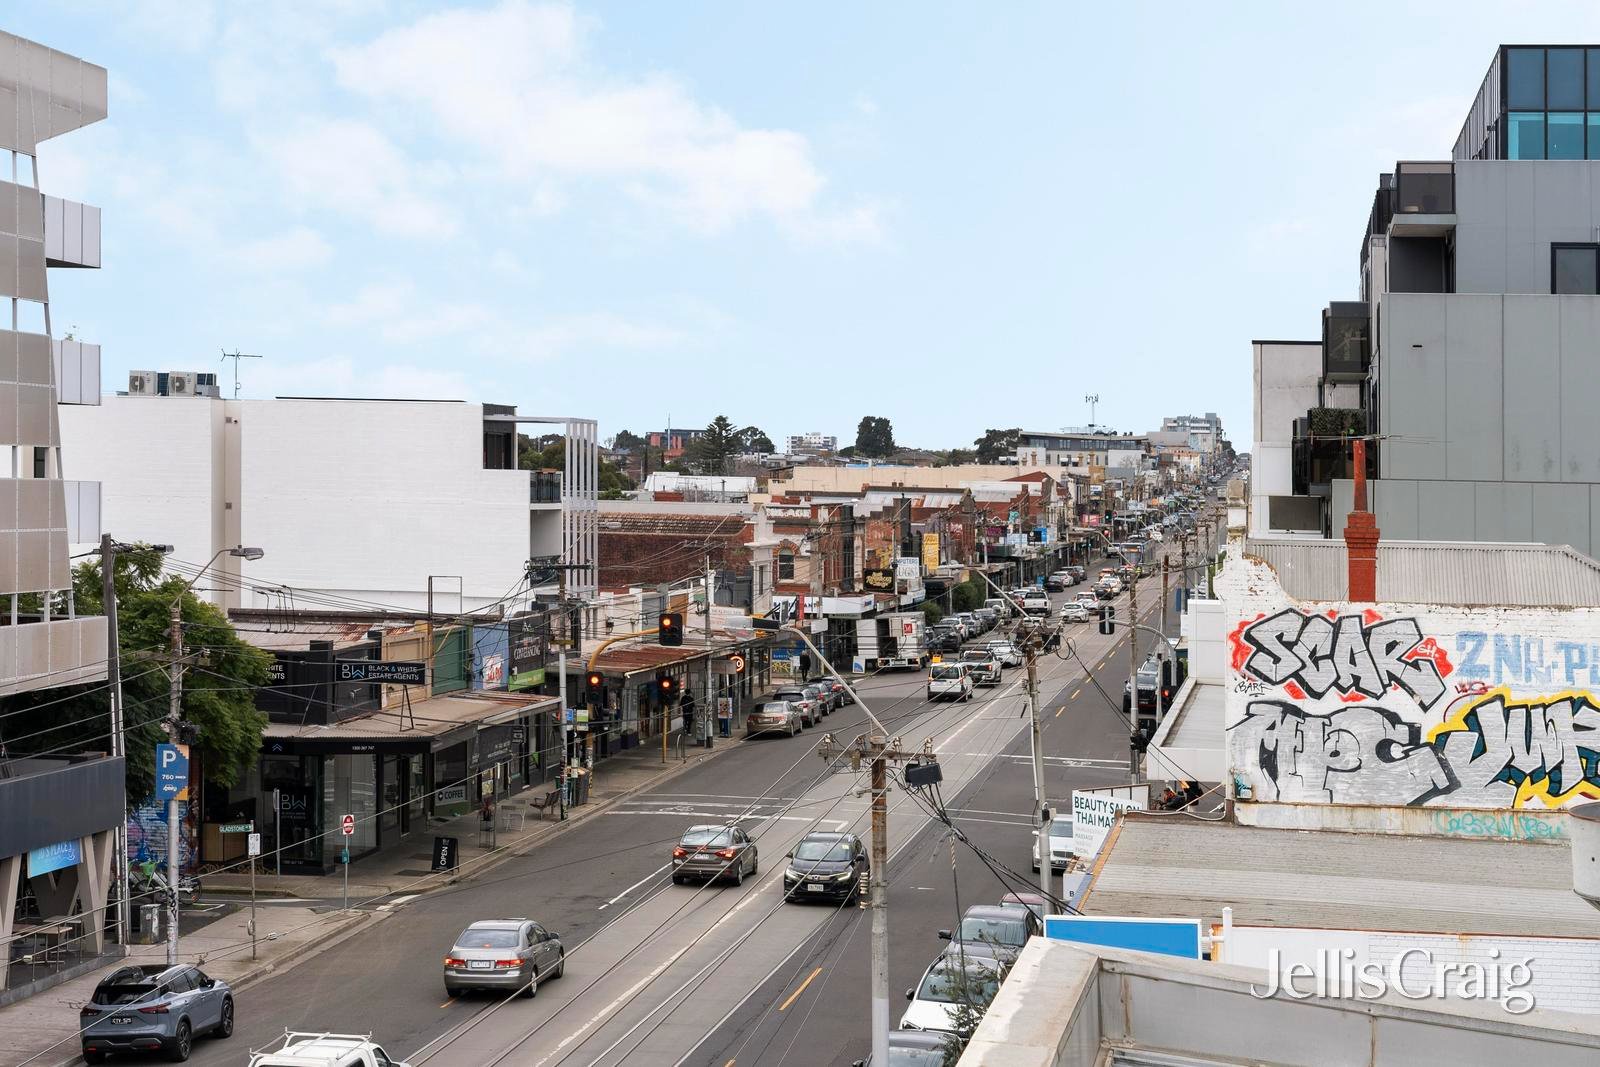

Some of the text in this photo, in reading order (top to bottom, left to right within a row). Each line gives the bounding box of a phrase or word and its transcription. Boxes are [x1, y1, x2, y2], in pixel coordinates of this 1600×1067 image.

[368, 664, 390, 673] BLACK
[397, 665, 418, 674] WHITE
[368, 672, 419, 681] ESTATE AGENTS
[162, 750, 177, 768] P
[444, 788, 464, 800] COFFEE
[1074, 796, 1108, 812] BEAUTY
[1076, 811, 1097, 826] THAI
[219, 825, 245, 833] GLADSTONE
[439, 846, 449, 866] OPEN
